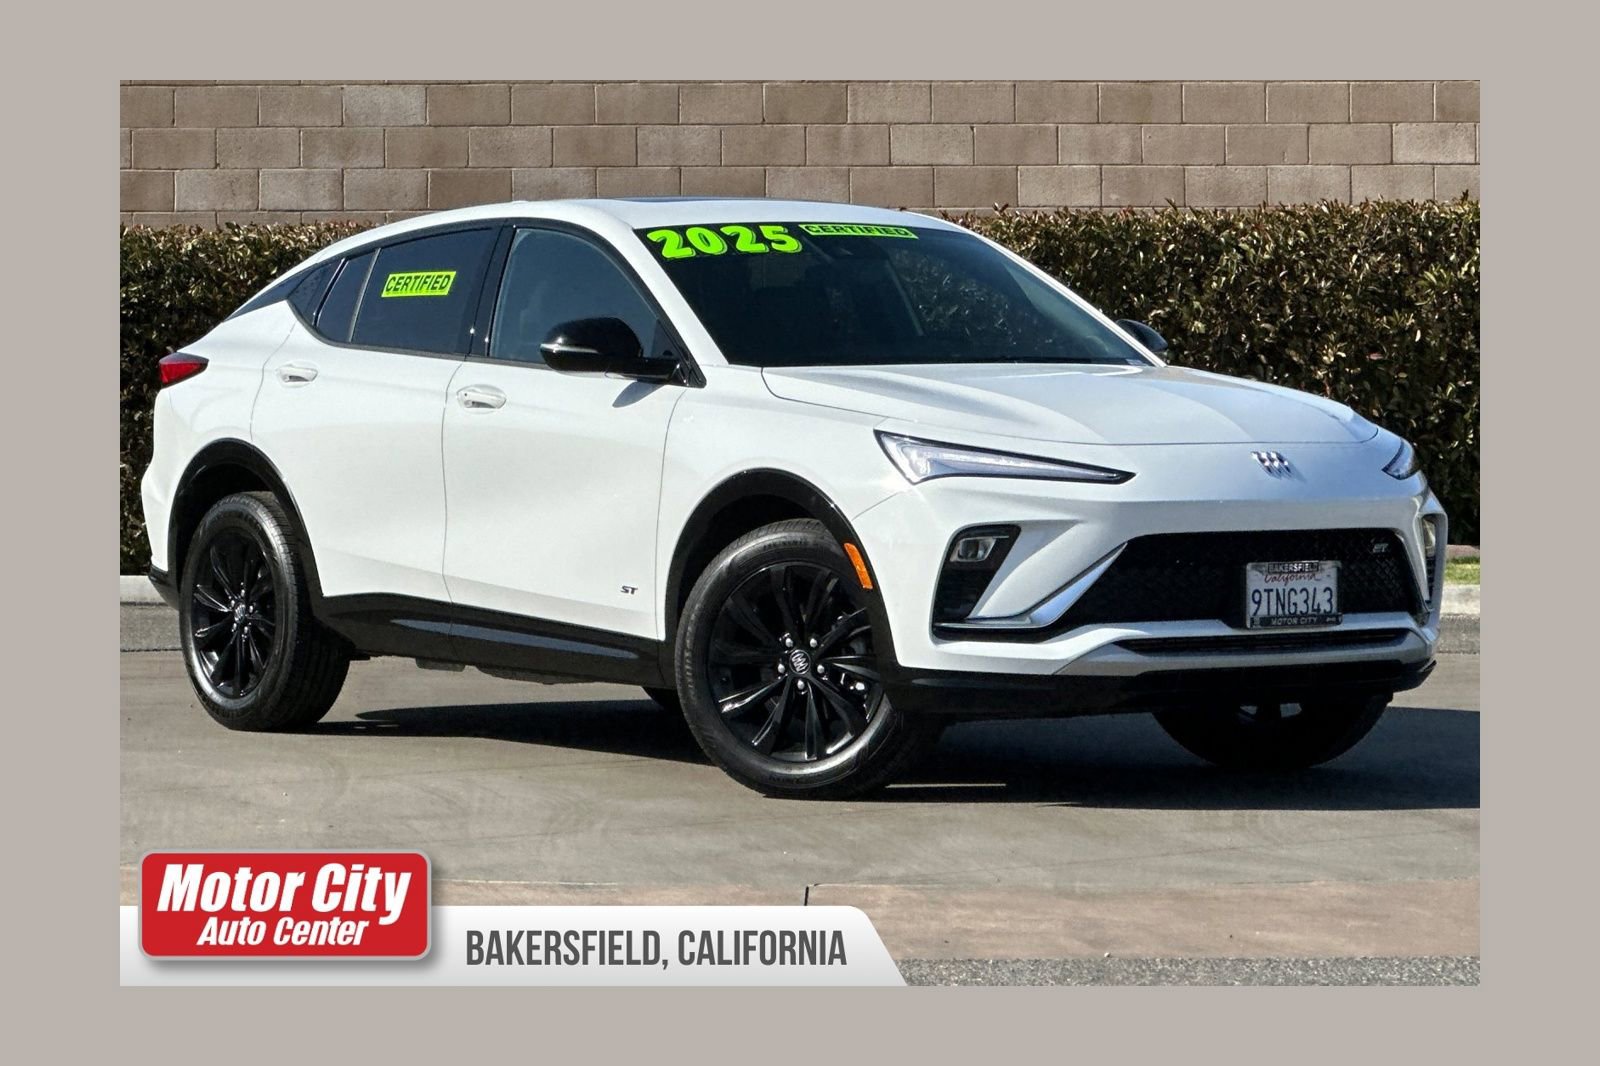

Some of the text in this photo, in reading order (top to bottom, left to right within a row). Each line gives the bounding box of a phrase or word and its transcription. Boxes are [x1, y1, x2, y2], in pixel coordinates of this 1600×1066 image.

[804, 224, 909, 237] CERTIFIED
[647, 225, 802, 259] 2025
[386, 274, 451, 292] CERTIFIED
[1268, 563, 1319, 573] BAKERSFIELD
[620, 585, 638, 595] ST
[1251, 587, 1333, 617] 9TNG343
[1271, 617, 1298, 626] MOTOR
[1300, 617, 1317, 625] CITY
